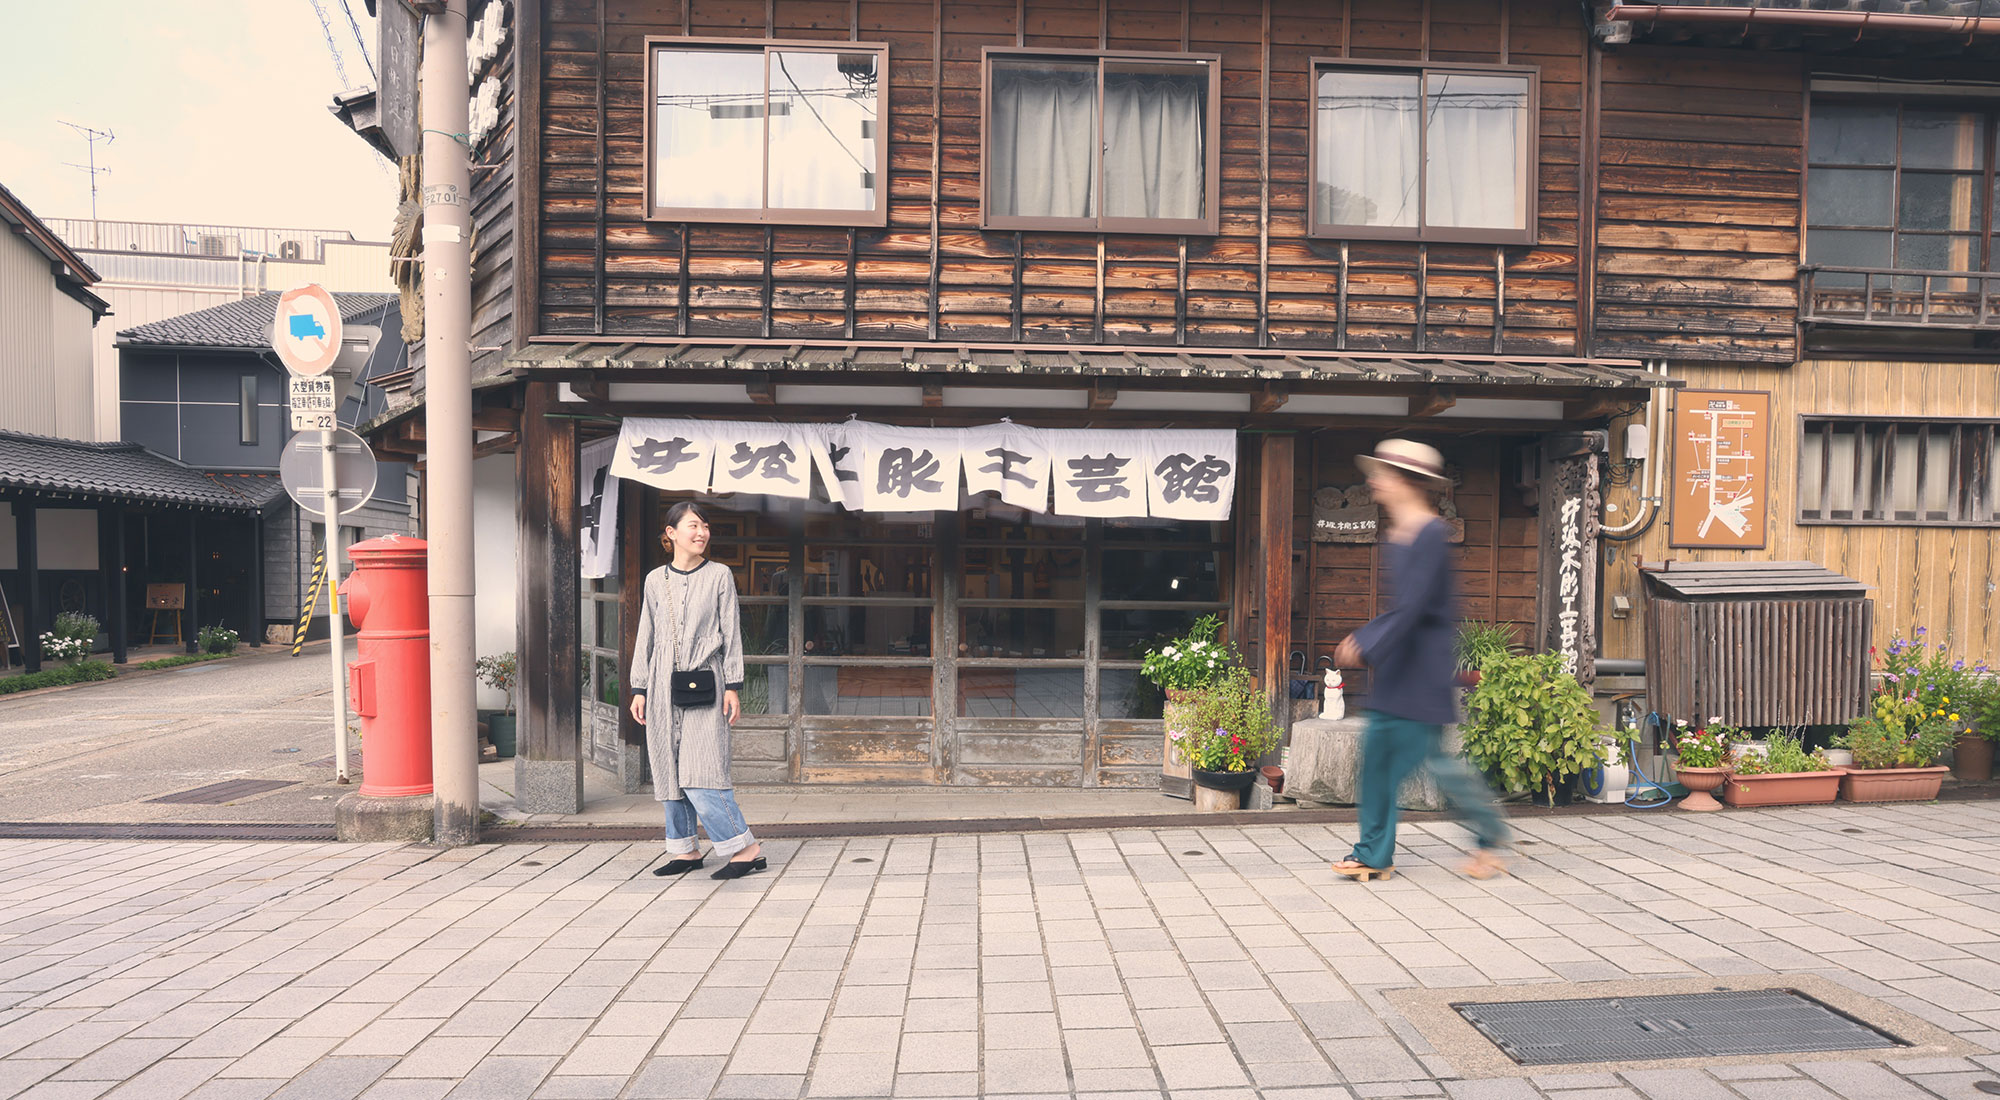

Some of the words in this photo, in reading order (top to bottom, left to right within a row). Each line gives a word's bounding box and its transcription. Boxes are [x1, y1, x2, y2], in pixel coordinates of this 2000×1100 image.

[292, 380, 331, 393] 大型貨物等
[1316, 519, 1377, 531] 井波木彫工芸館
